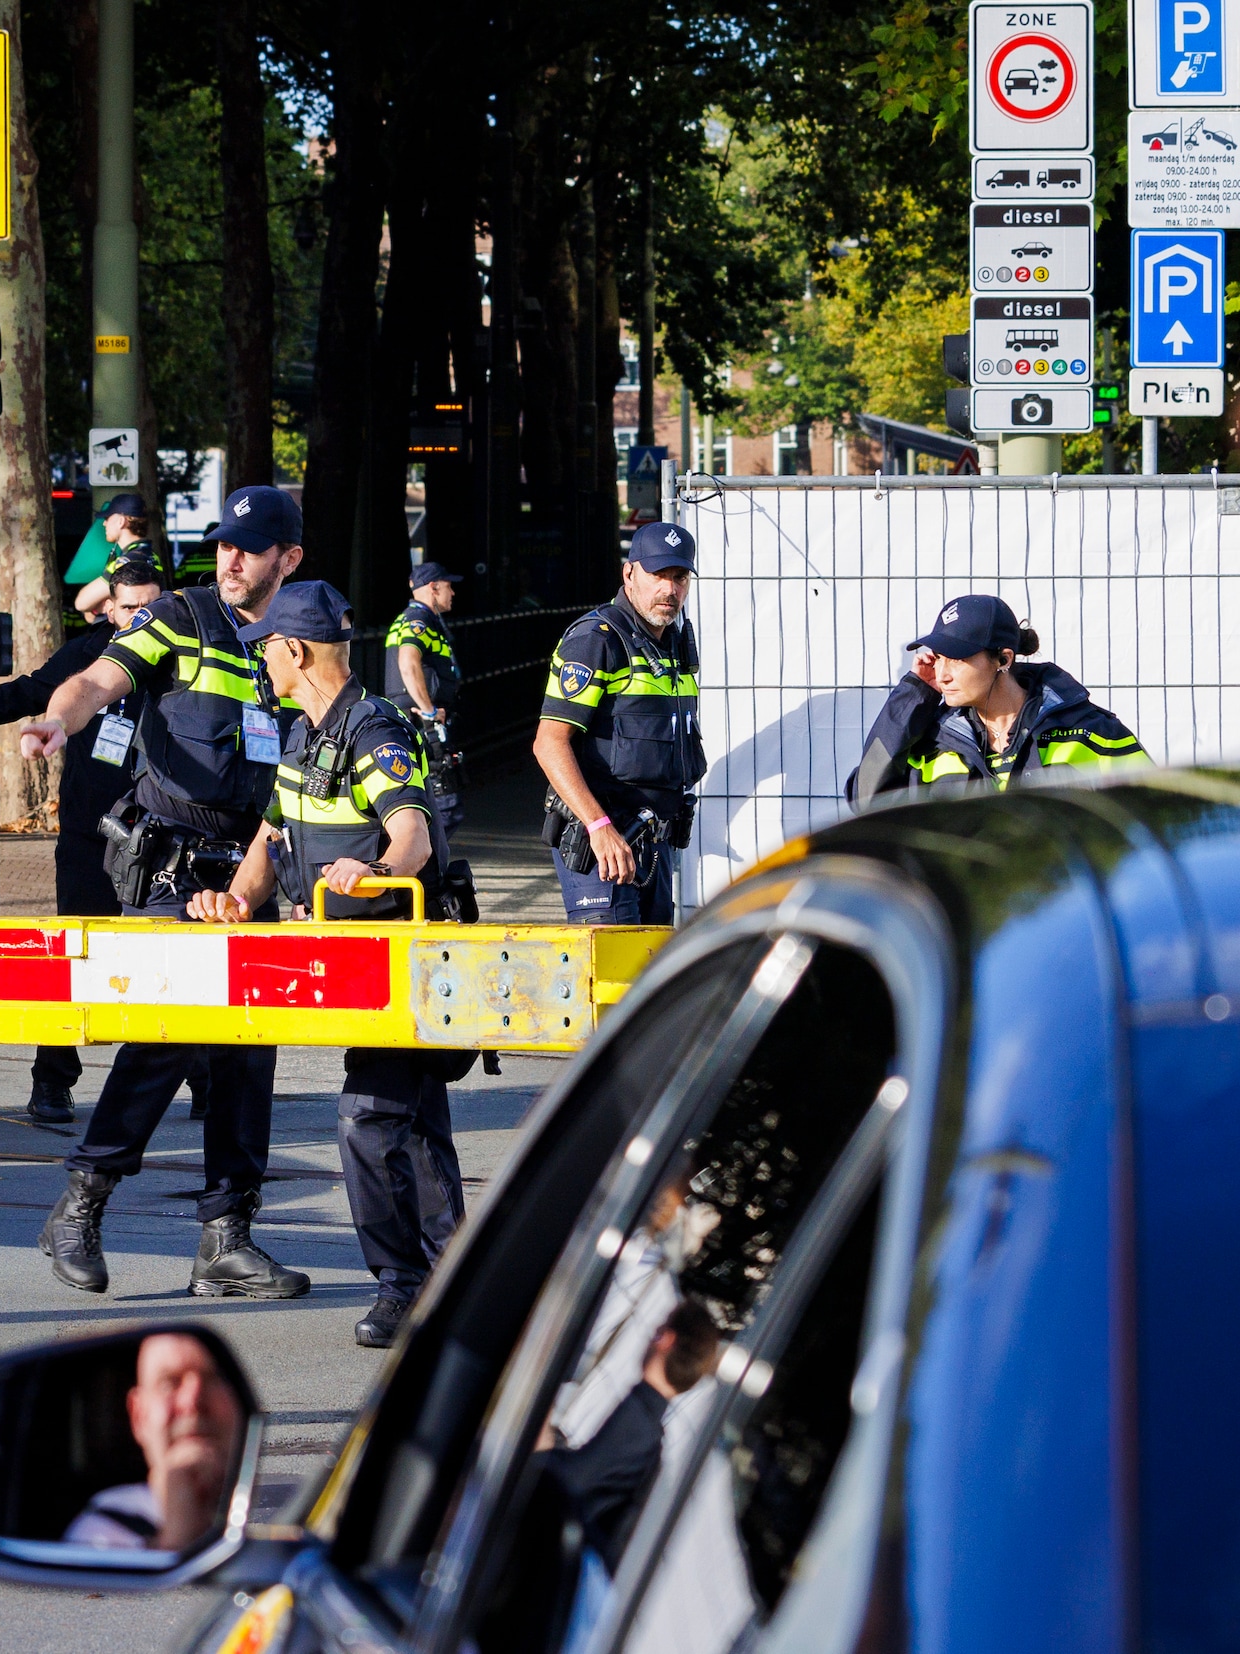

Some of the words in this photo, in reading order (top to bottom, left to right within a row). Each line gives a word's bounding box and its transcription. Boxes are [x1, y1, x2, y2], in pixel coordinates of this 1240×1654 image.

[1006, 13, 1057, 26] ZONE
[1174, 1, 1210, 52] P
[1148, 154, 1179, 165] maandag
[1182, 154, 1196, 163] t/m
[1198, 154, 1235, 165] donderdag
[1212, 167, 1217, 176] h
[1134, 179, 1158, 191] vrijdag
[1160, 179, 1180, 189] 09.00
[1189, 179, 1220, 191] zaterdag
[1134, 192, 1165, 204] zaterdag
[1167, 191, 1187, 201] 09.00
[1195, 192, 1220, 204] zondag
[1152, 205, 1178, 216] zondag
[1225, 205, 1231, 214] h
[1002, 209, 1060, 224] diesel
[1165, 219, 1182, 227] max.
[1186, 217, 1198, 227] 120
[1200, 218, 1215, 227] min.
[982, 270, 990, 279] 0
[1018, 269, 1027, 280] 2
[1038, 270, 1045, 279] 3
[1003, 301, 1060, 316] diesel
[98, 339, 126, 348] M5186
[982, 363, 990, 372] 0
[1018, 362, 1027, 372] 2
[1038, 363, 1045, 372] 3
[1055, 362, 1064, 372] 4
[1074, 362, 1083, 372] 5
